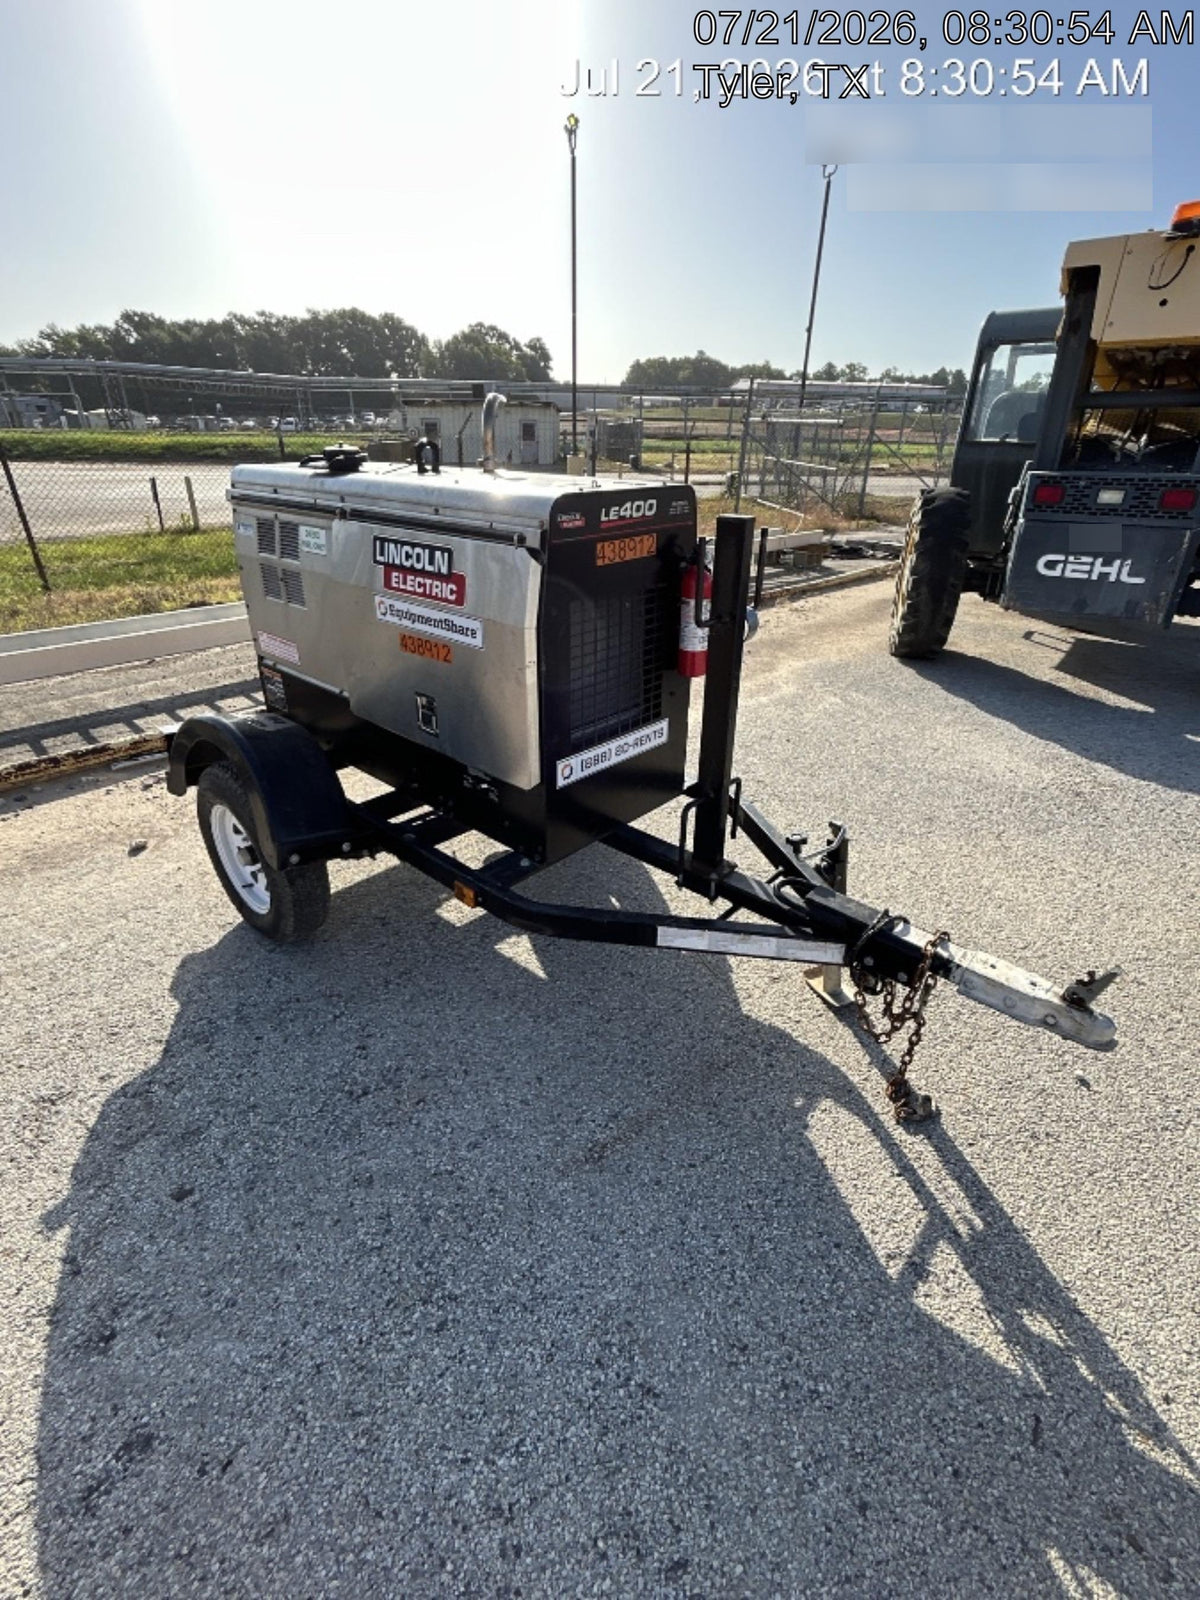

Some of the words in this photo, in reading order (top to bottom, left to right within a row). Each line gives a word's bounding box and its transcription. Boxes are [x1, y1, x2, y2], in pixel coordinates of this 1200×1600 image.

[600, 499, 657, 522] LE400
[375, 540, 449, 575] LINCOLN
[597, 534, 657, 564] 438912
[1036, 554, 1146, 584] GEHL
[391, 572, 458, 601] ELECTRIC
[388, 603, 478, 639] EquipmentShare
[399, 634, 453, 664] 438912
